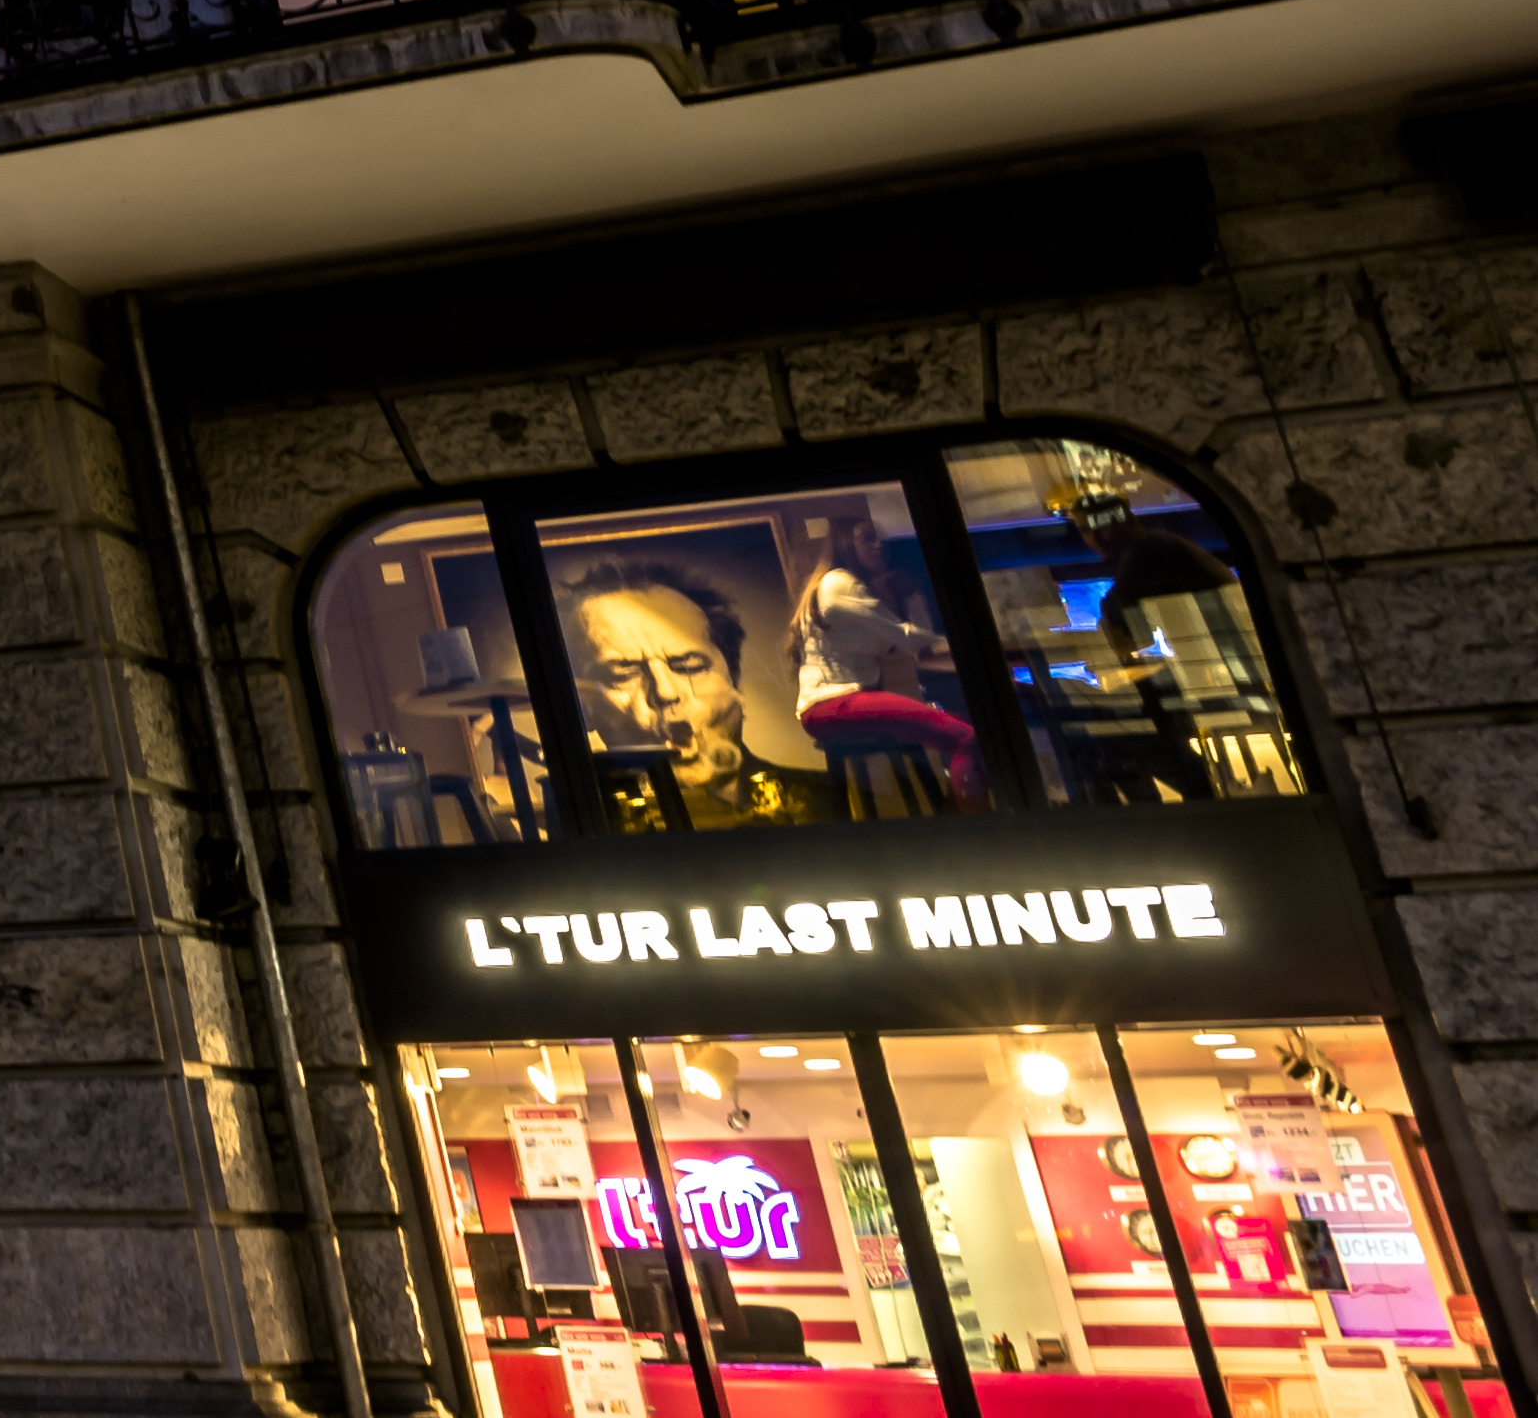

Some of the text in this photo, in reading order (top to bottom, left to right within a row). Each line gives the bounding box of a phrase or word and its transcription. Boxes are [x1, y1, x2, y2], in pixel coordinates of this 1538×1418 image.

[689, 900, 879, 959] LAST
[899, 883, 1226, 950] MINUTE
[1337, 1239, 1410, 1258] UCHEN
